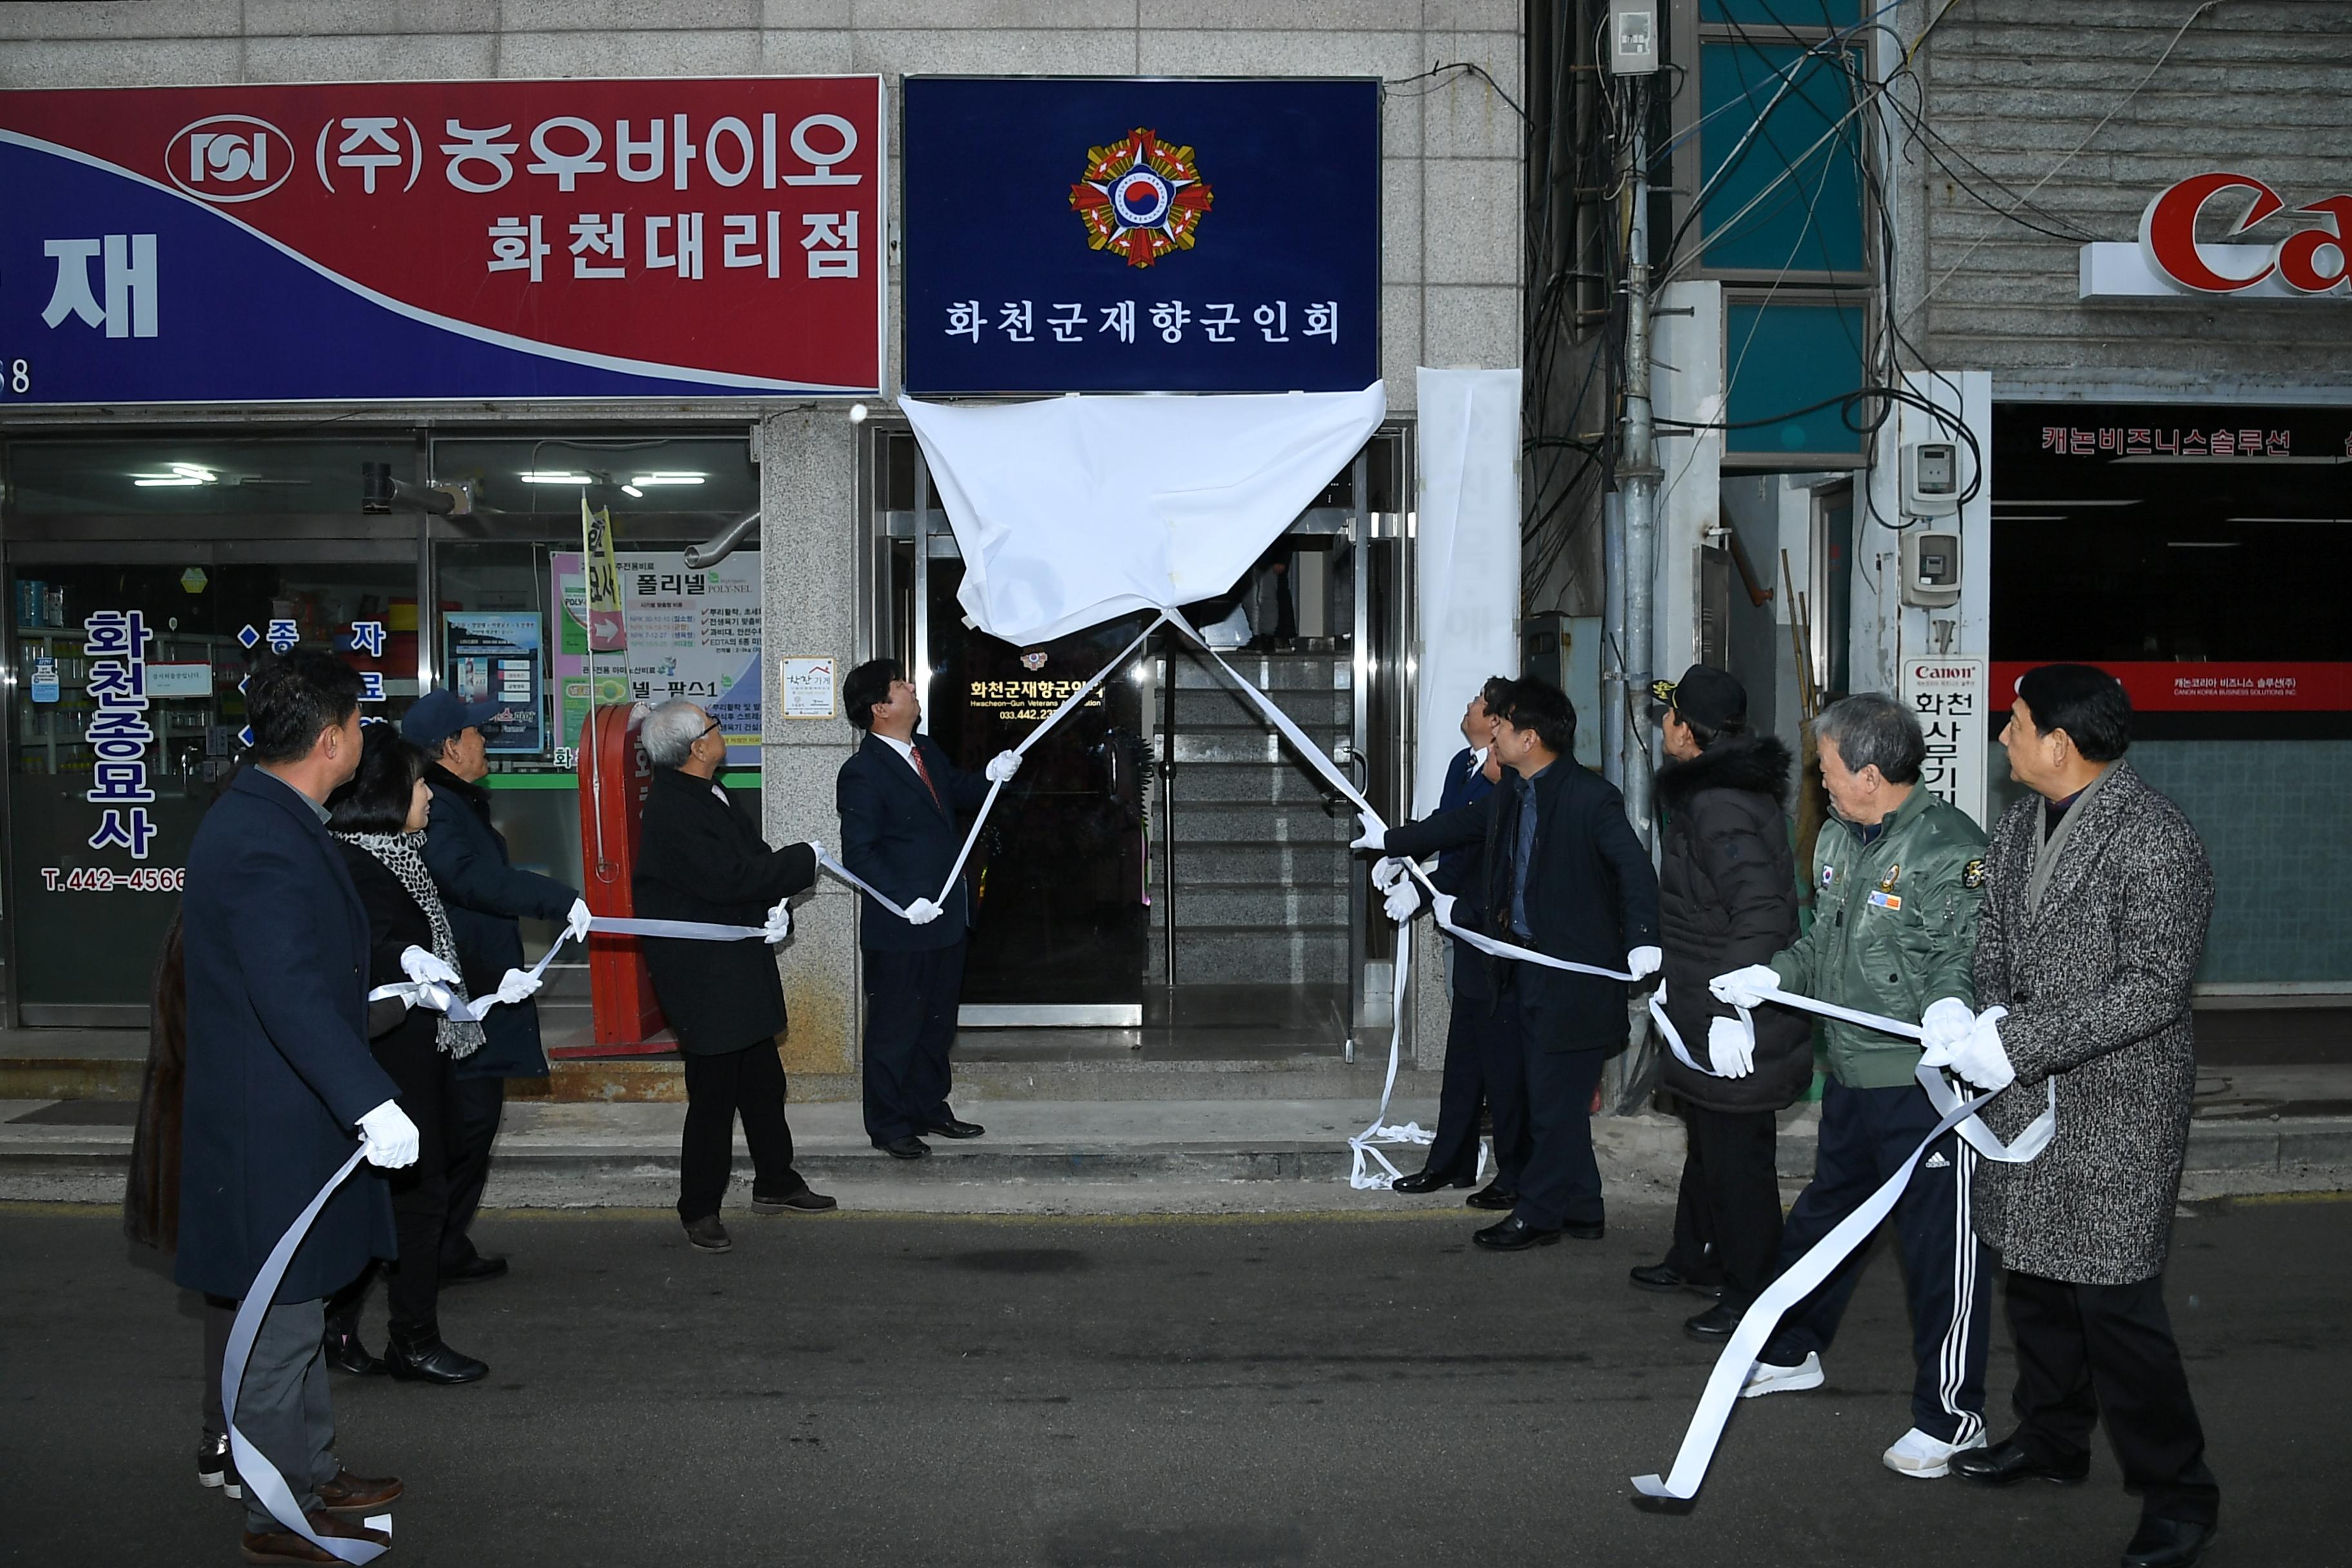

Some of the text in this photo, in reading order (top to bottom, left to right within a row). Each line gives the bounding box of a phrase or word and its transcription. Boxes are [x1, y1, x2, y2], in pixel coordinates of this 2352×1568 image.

[487, 210, 859, 282] 화천대리점
[41, 233, 159, 338] 재
[944, 300, 1338, 345] 화천군재향군인회
[2042, 427, 2291, 456] 캐논비즈니스솔루션
[637, 574, 705, 595] 폴리넬
[708, 585, 753, 593] POLY-NEL
[565, 598, 587, 606] POLY-
[787, 675, 812, 685] 착한
[1916, 665, 1975, 679] Canon
[970, 680, 1104, 698] 화천군재향군인
[2220, 678, 2254, 688] 비즈니스
[1916, 692, 1973, 716] 화천
[999, 709, 1057, 720] 033.442.23
[84, 610, 157, 859] 화천종묘사
